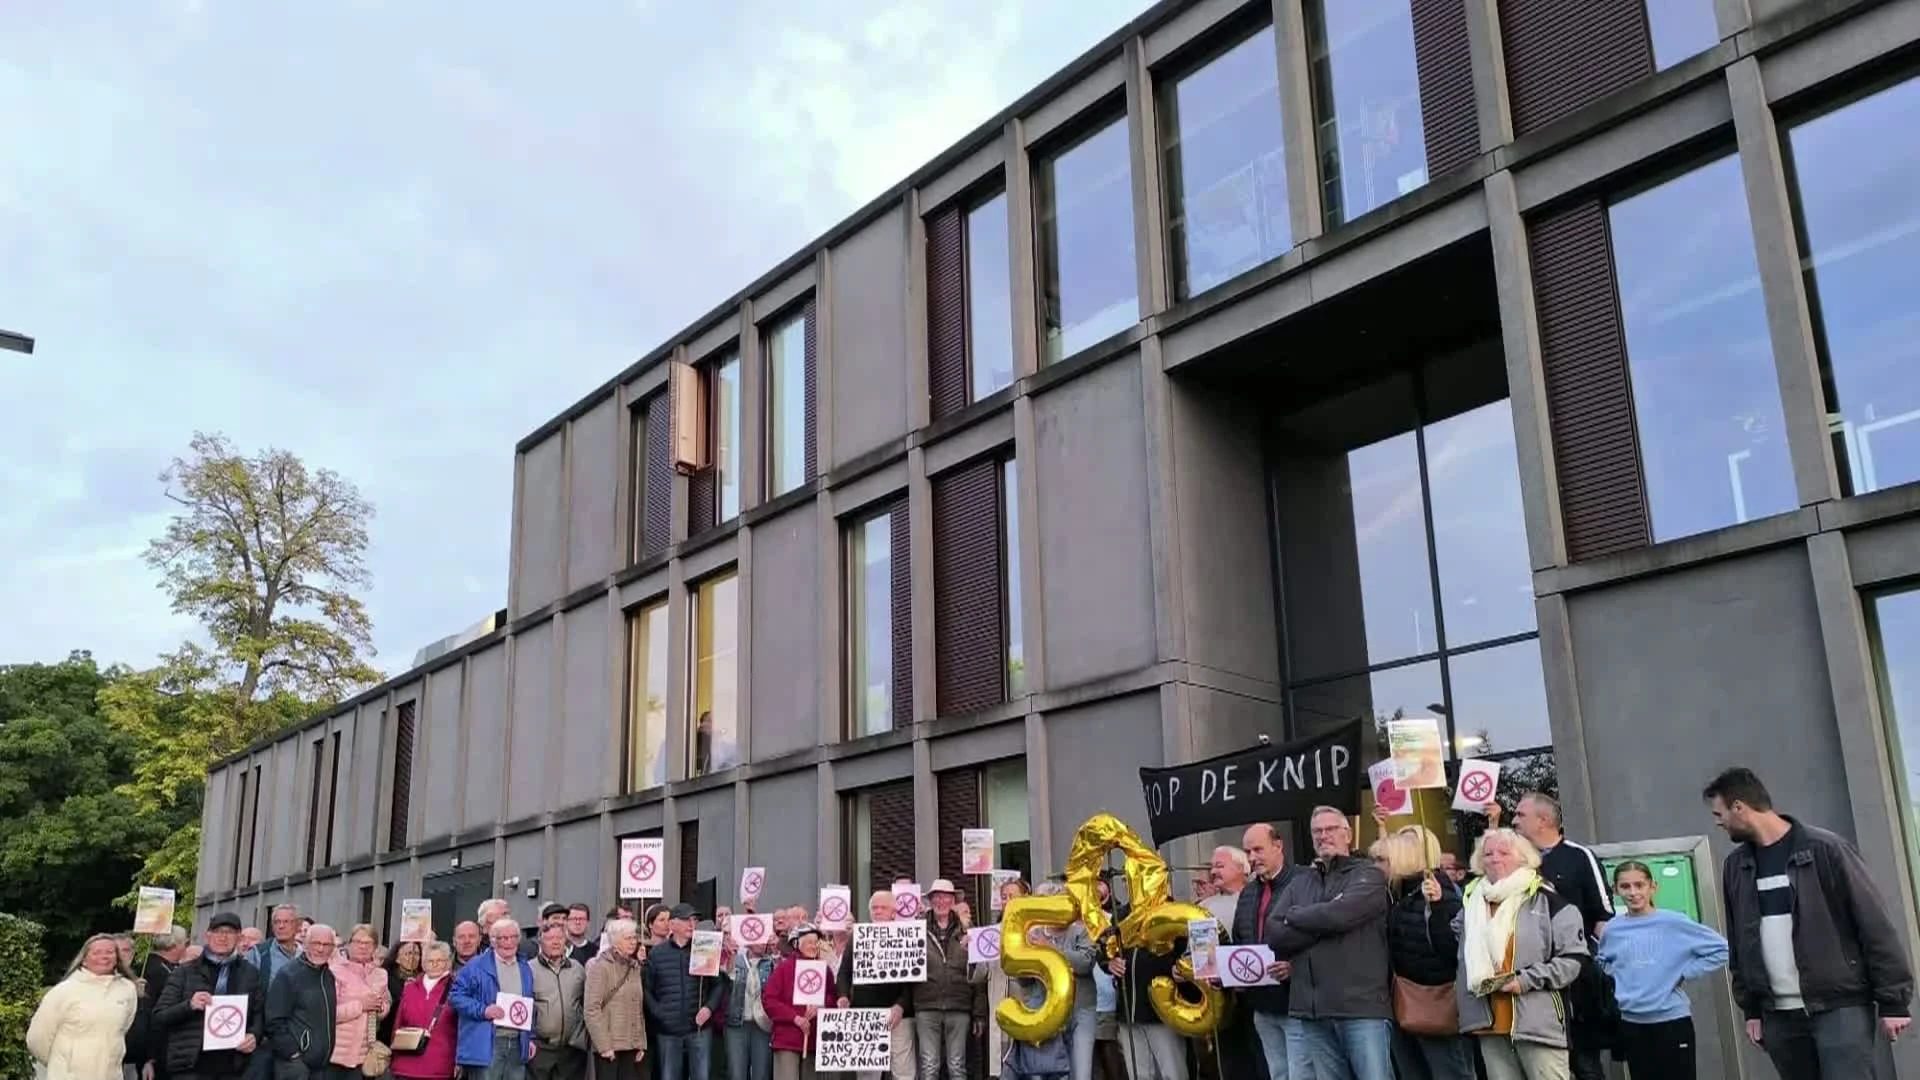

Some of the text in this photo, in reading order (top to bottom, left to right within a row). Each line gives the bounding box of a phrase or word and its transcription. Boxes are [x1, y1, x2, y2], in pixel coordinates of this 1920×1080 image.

[1201, 765, 1238, 805] DE
[1257, 744, 1351, 796] KNIP
[858, 926, 921, 939] SPEEL NIET
[855, 940, 877, 950] MET
[879, 938, 904, 949] ONZE
[877, 951, 902, 960] GEEN
[995, 893, 1078, 1042] 5
[835, 1021, 866, 1032] STEN
[821, 1043, 876, 1057] GANG 7/7
[821, 1055, 846, 1068] DAG
[858, 1055, 890, 1067] NACHT
